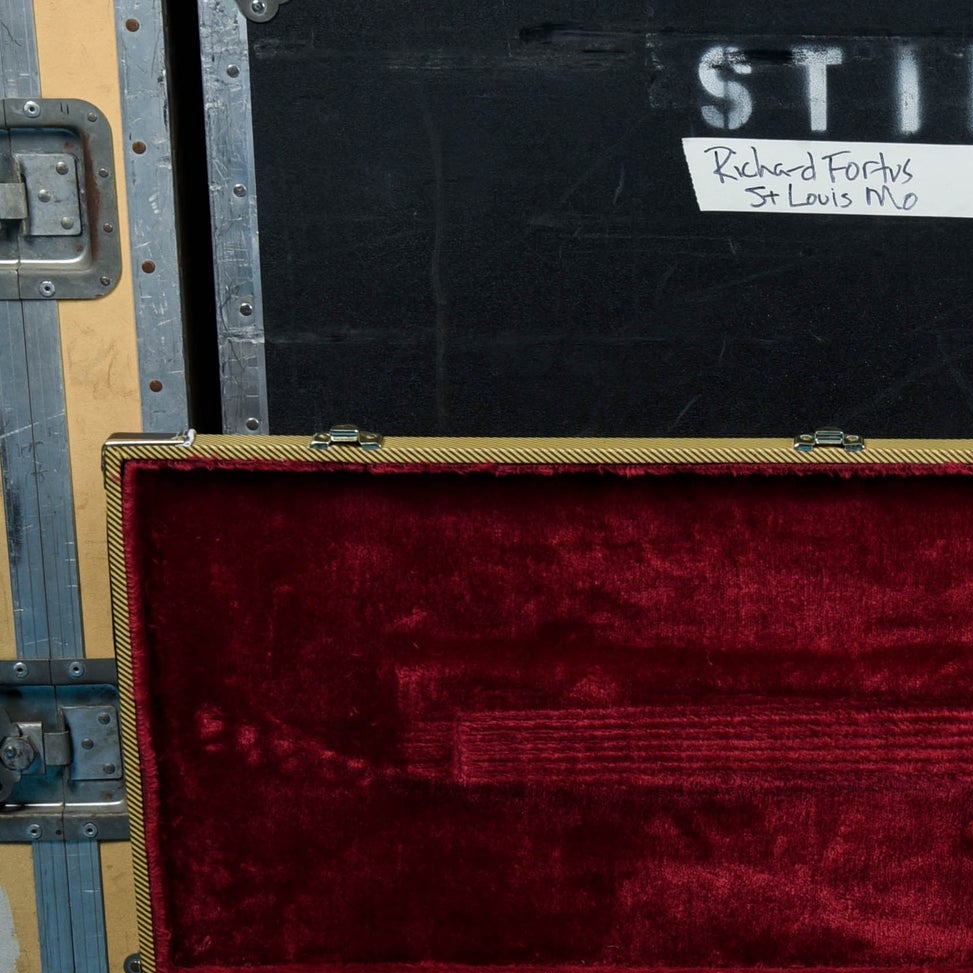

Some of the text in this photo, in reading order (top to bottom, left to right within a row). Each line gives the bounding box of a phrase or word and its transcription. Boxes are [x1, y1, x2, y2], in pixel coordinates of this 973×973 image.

[704, 146, 816, 184] Richard
[745, 185, 779, 208] St
[788, 183, 853, 209] Louis
